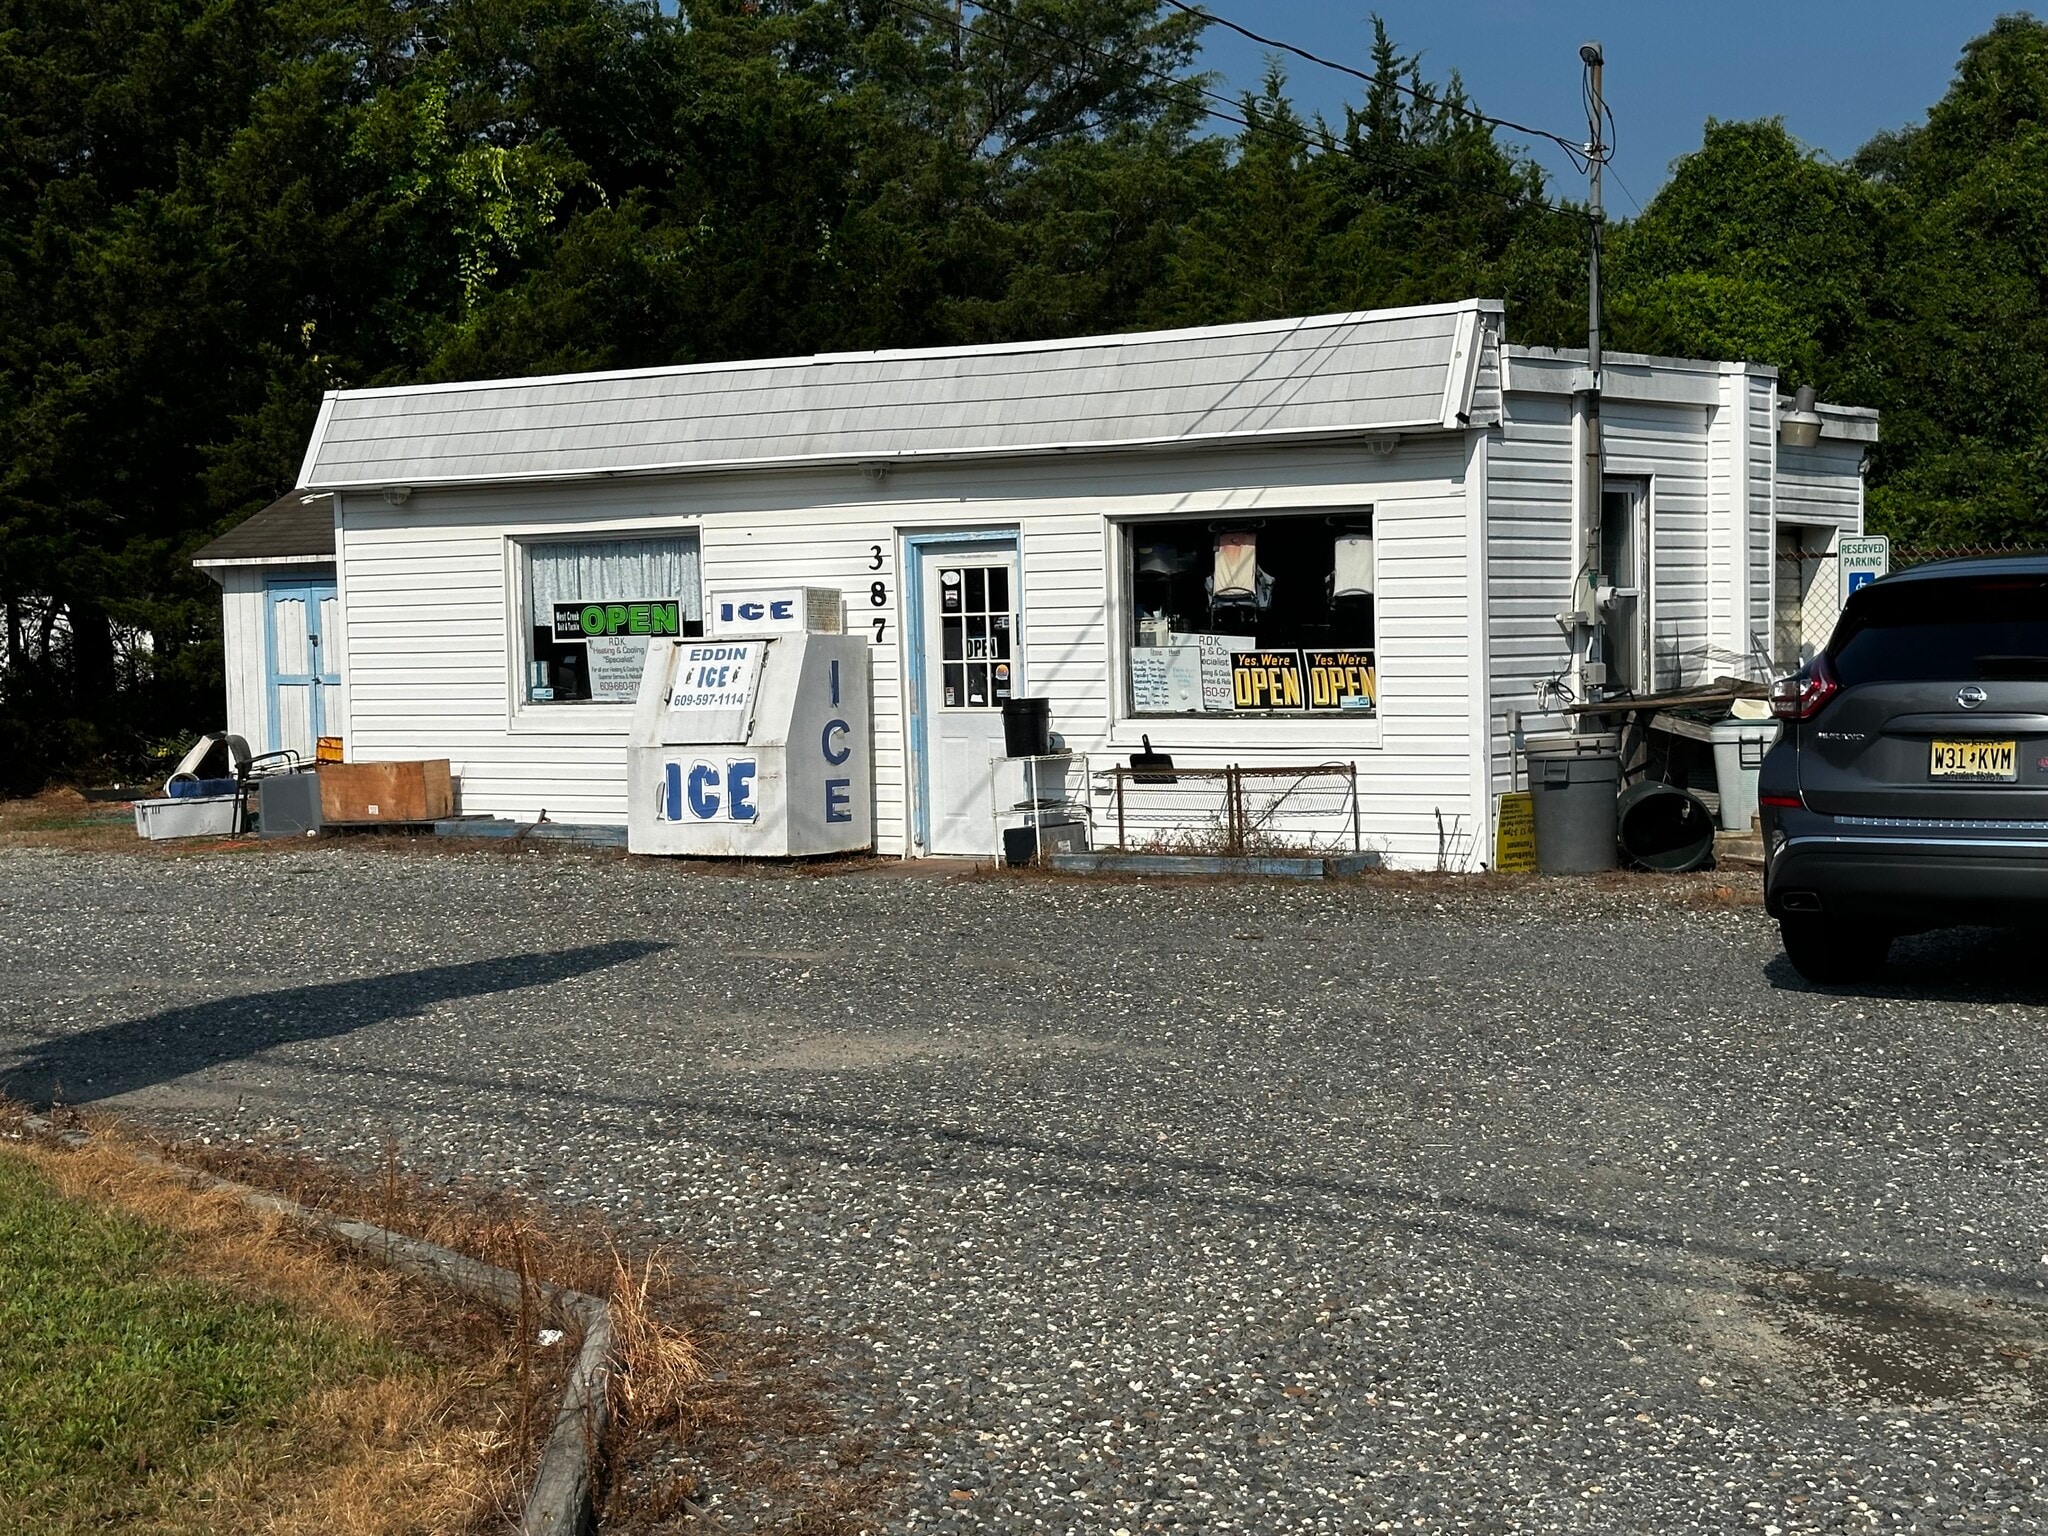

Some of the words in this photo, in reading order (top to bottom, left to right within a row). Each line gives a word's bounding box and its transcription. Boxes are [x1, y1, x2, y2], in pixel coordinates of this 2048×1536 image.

[1841, 543, 1884, 554] RESERVED
[1843, 556, 1882, 567] PARKING
[580, 604, 678, 635] OPEN
[720, 600, 794, 622] ICE
[623, 647, 644, 655] Cooling
[689, 648, 747, 662] EDDIN
[967, 638, 997, 658] OPEN
[1238, 654, 1259, 667] Yes,
[1261, 654, 1290, 666] We're
[1338, 654, 1367, 666] We're
[697, 665, 730, 688] ICE
[1233, 667, 1301, 706] OPEN
[1310, 667, 1376, 706] OPEN
[674, 693, 744, 707] 609-597-1114
[664, 758, 757, 821] ICE
